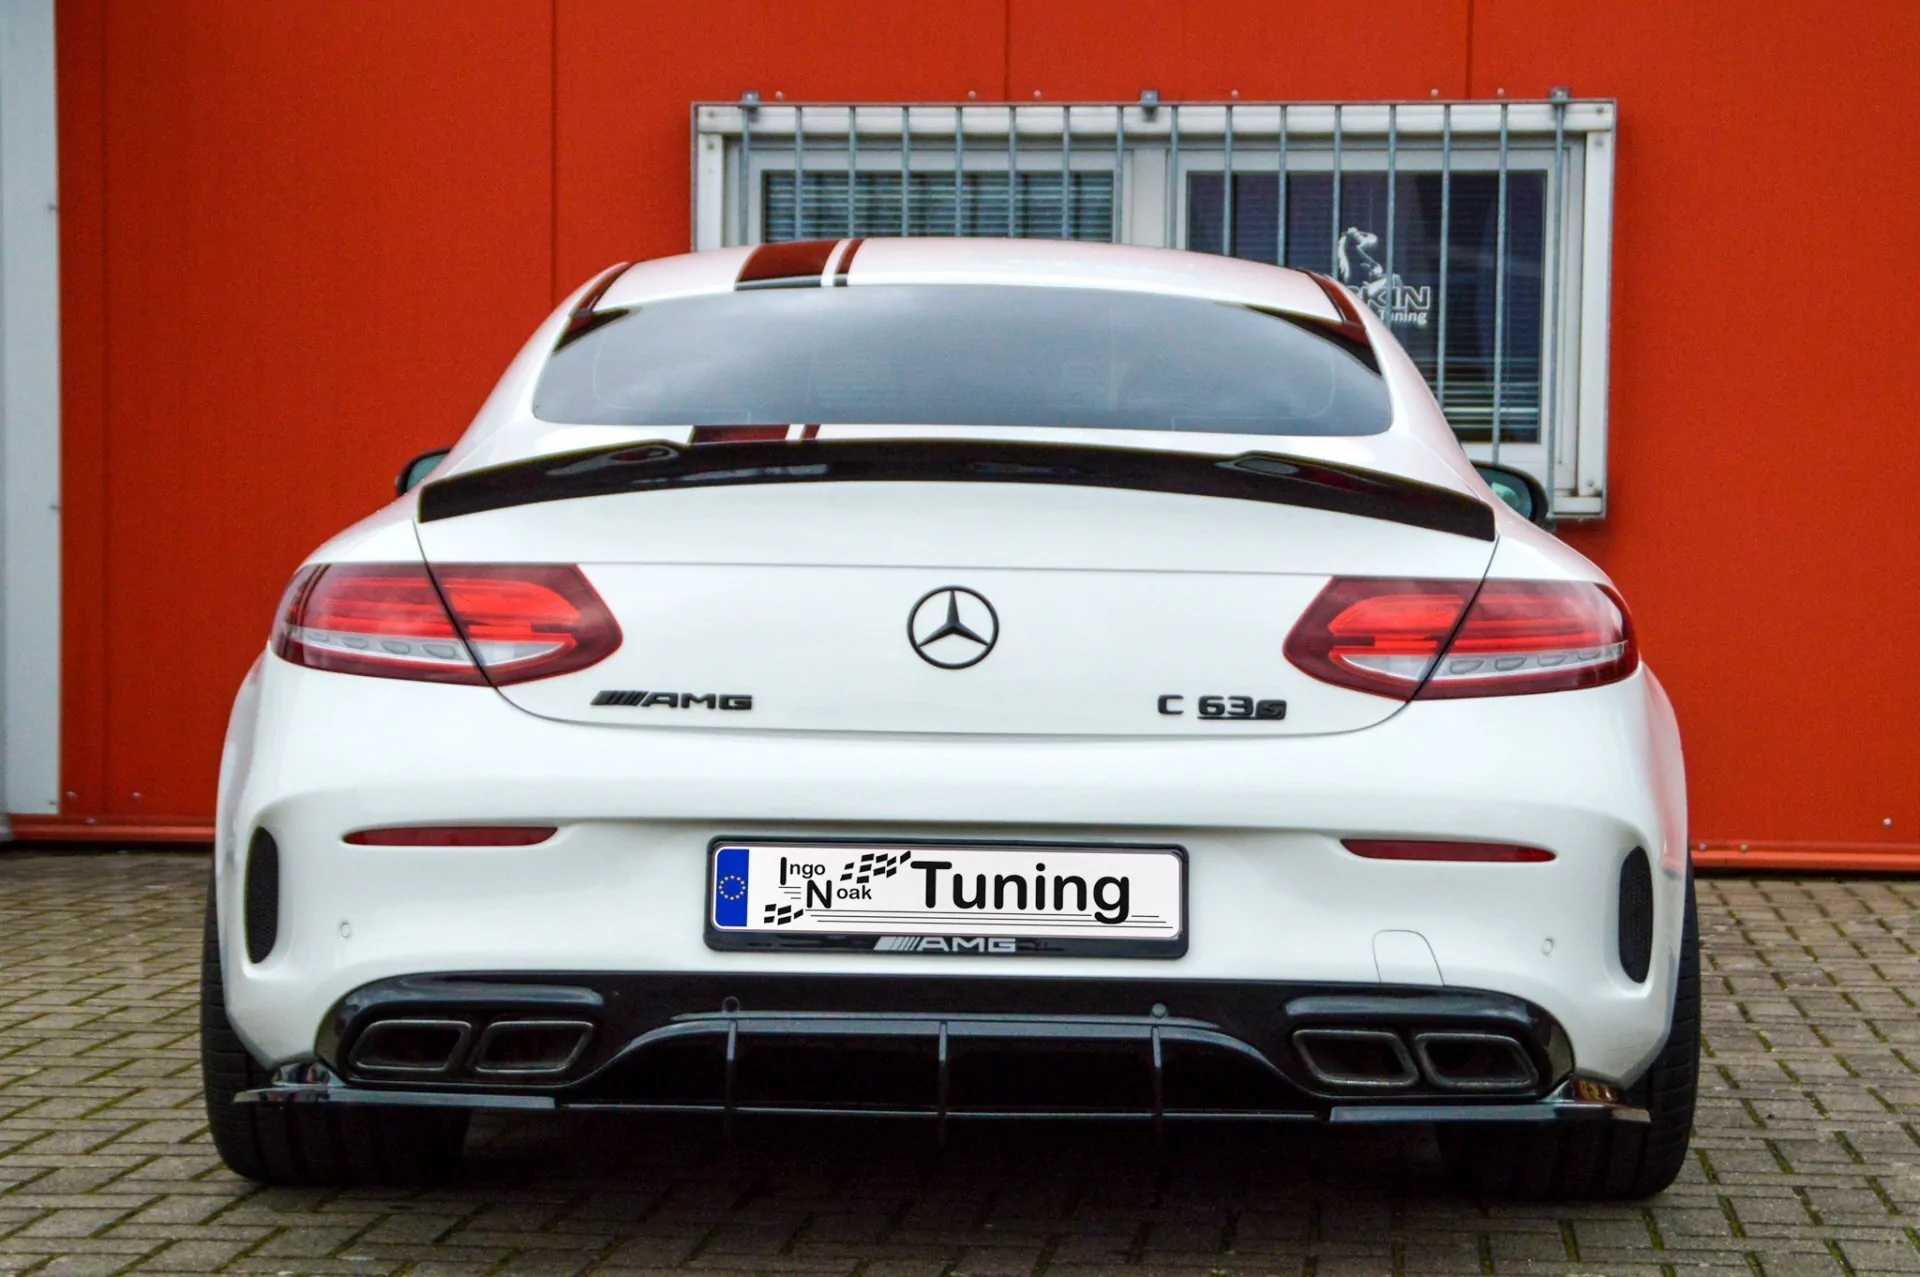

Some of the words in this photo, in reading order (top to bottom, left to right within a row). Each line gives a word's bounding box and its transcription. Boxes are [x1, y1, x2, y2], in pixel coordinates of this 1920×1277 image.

[640, 691, 753, 711] AMG
[1157, 694, 1184, 715] C
[780, 856, 826, 886] Ingo
[806, 879, 872, 909] Noak
[910, 860, 1131, 924] Tuning
[917, 936, 1017, 953] AMG
